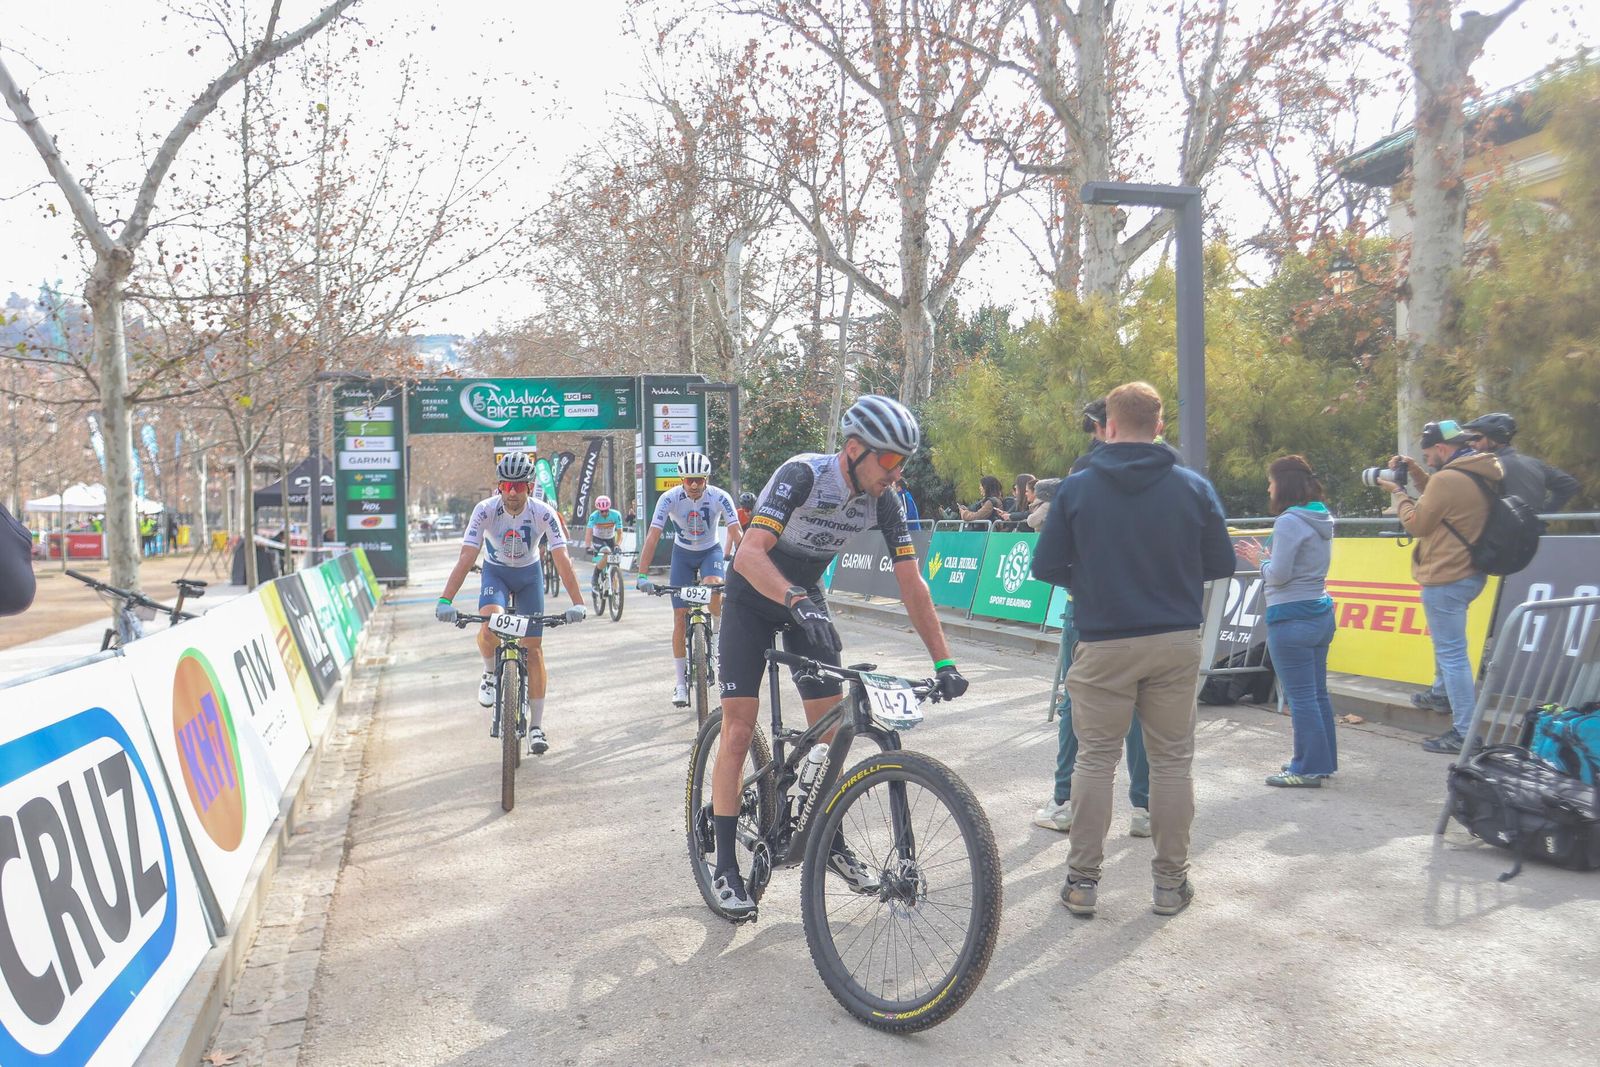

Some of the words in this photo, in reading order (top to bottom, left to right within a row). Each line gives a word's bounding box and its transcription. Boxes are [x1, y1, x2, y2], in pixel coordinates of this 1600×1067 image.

[487, 405, 519, 419] BIKE
[522, 405, 560, 419] RACE
[348, 456, 391, 465] GARMIN
[576, 451, 598, 518] GARMIN
[841, 552, 873, 570] GARMIN
[944, 556, 958, 569] CAJA
[958, 557, 978, 570] RURAL
[948, 570, 965, 583] JAÉN
[686, 588, 707, 601] 69-2
[989, 595, 1006, 606] SPORT
[1006, 597, 1032, 609] BEARINGS
[496, 614, 522, 633] 69-1
[1219, 630, 1252, 644] EATH
[873, 690, 913, 715] 14-2
[178, 692, 239, 815] KH7
[840, 763, 881, 794] PIRELLI
[796, 756, 831, 832] cannondale
[0, 749, 167, 1027] CRUZ
